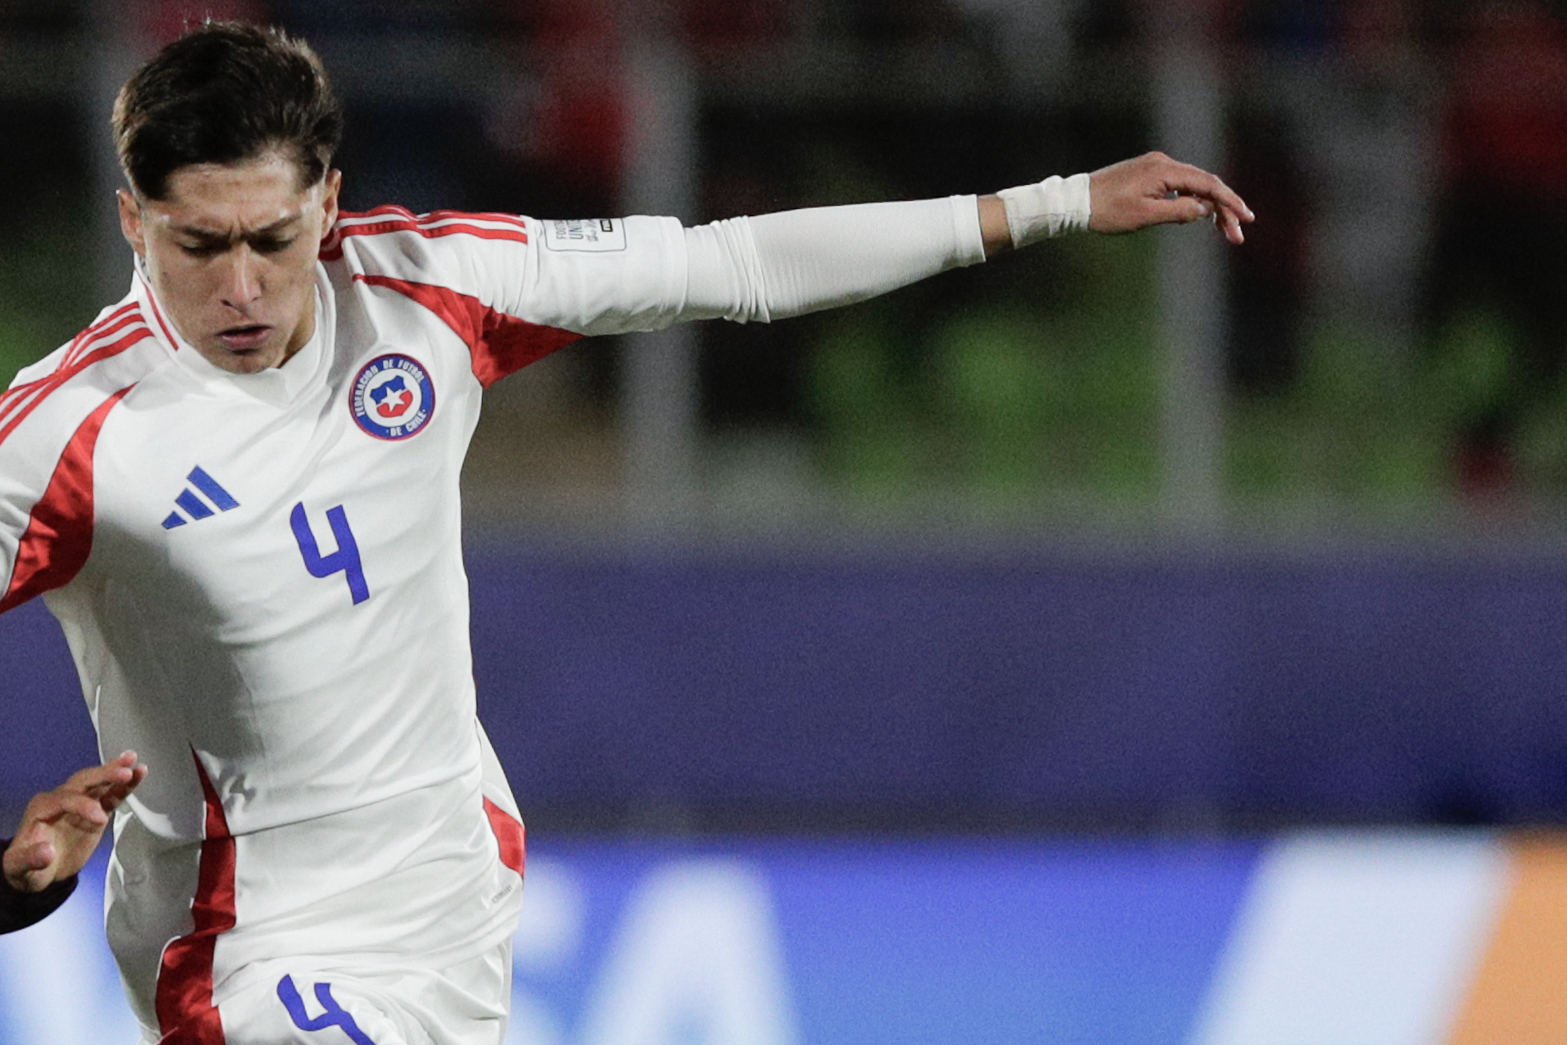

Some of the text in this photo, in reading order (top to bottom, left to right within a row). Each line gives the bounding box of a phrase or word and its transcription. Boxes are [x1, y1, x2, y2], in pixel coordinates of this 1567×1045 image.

[382, 359, 394, 369] DE
[390, 410, 427, 437] DE CHILE
[289, 501, 370, 606] 4
